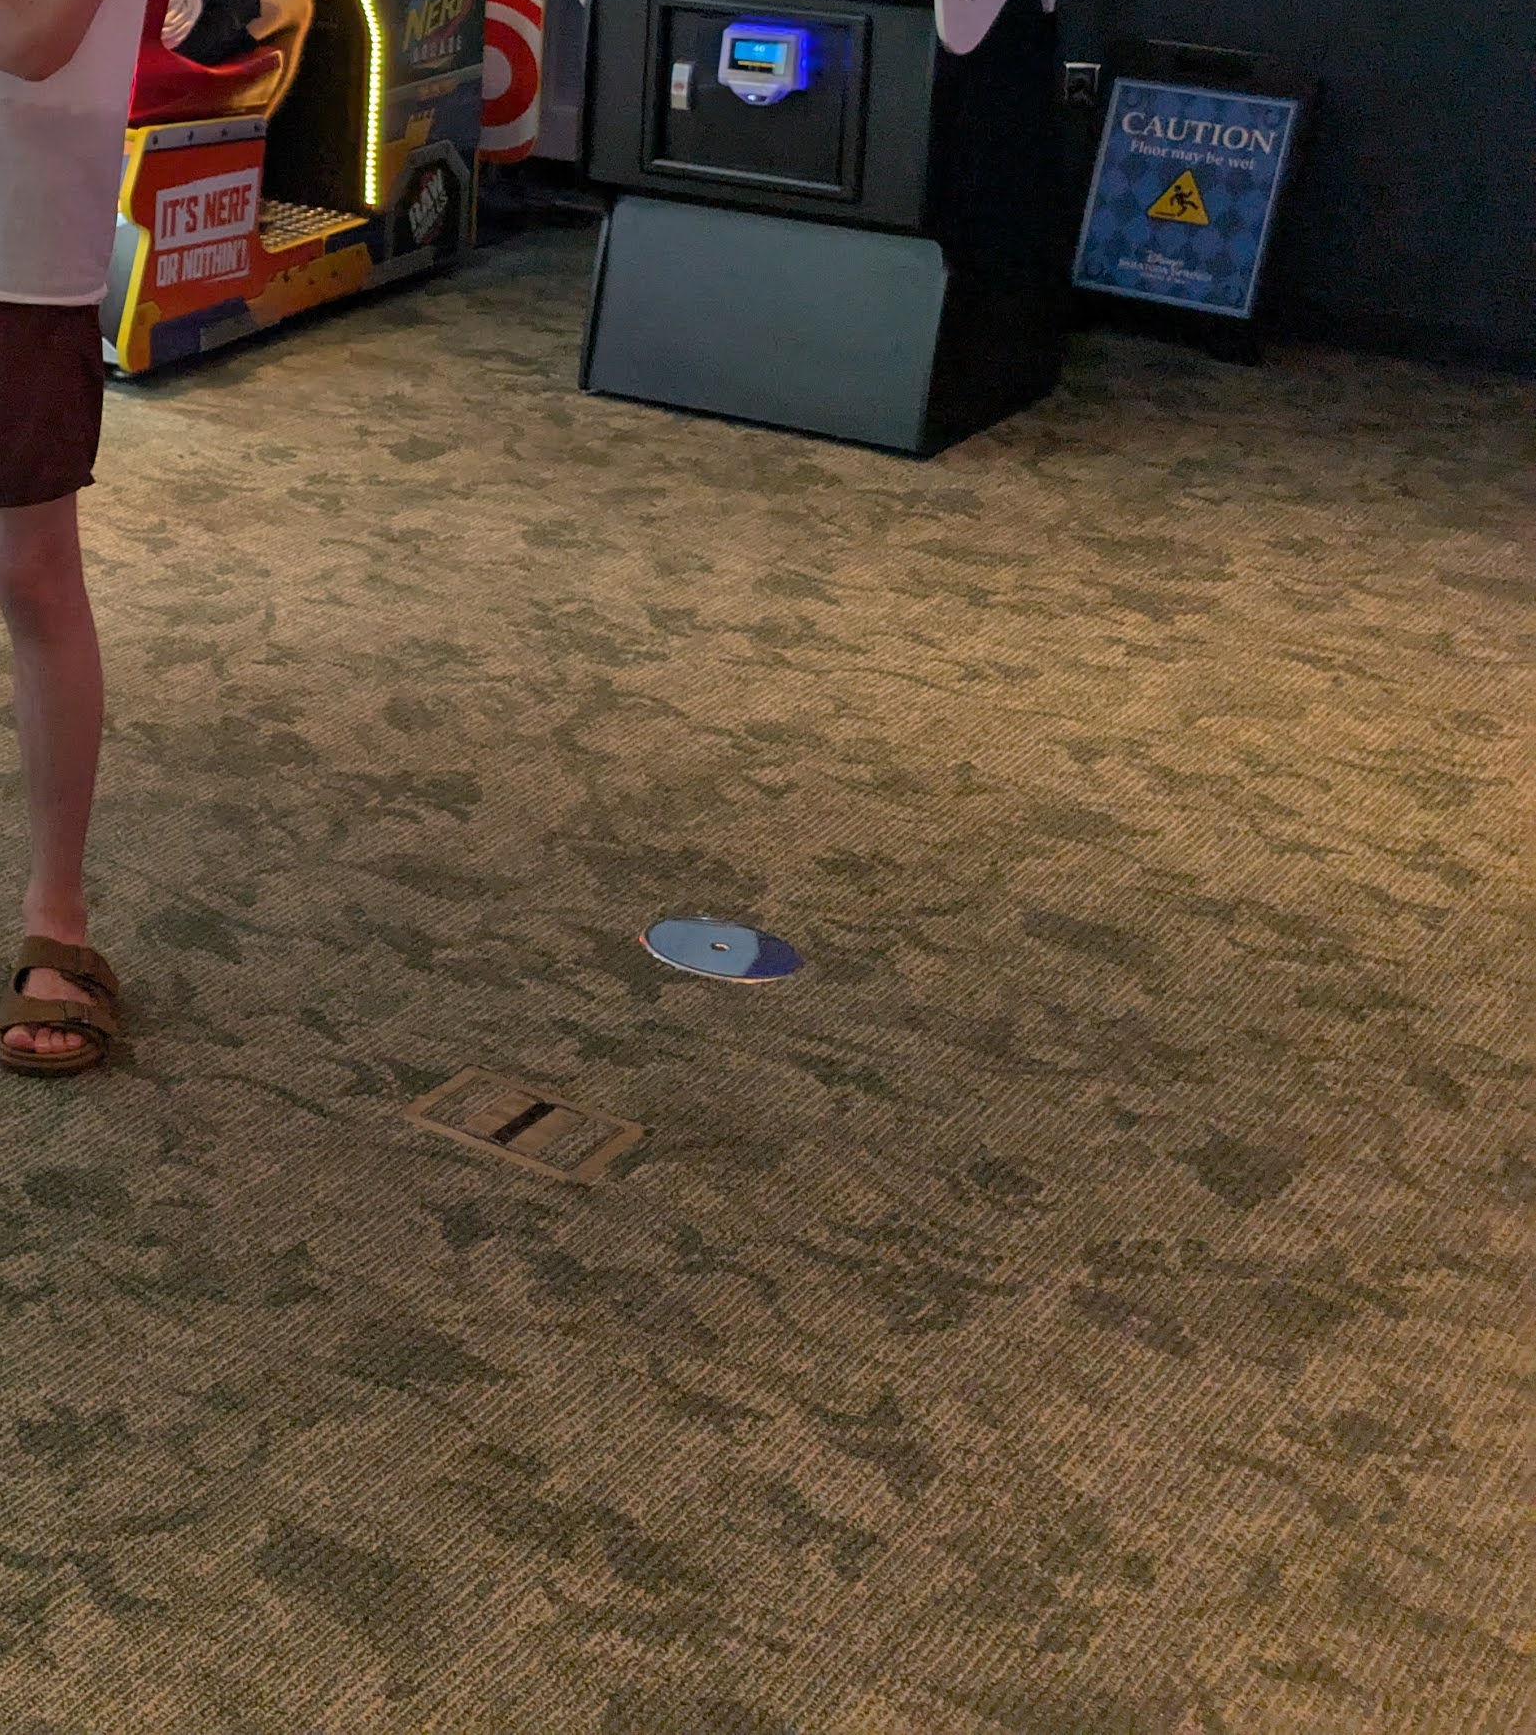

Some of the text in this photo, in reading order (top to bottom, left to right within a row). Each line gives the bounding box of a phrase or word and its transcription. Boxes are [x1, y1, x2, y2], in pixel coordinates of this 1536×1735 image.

[1122, 111, 1276, 155] CAUTION
[1130, 140, 1256, 171] Floor may be wet
[161, 183, 252, 239] IT'S NERF
[156, 252, 179, 287] OR
